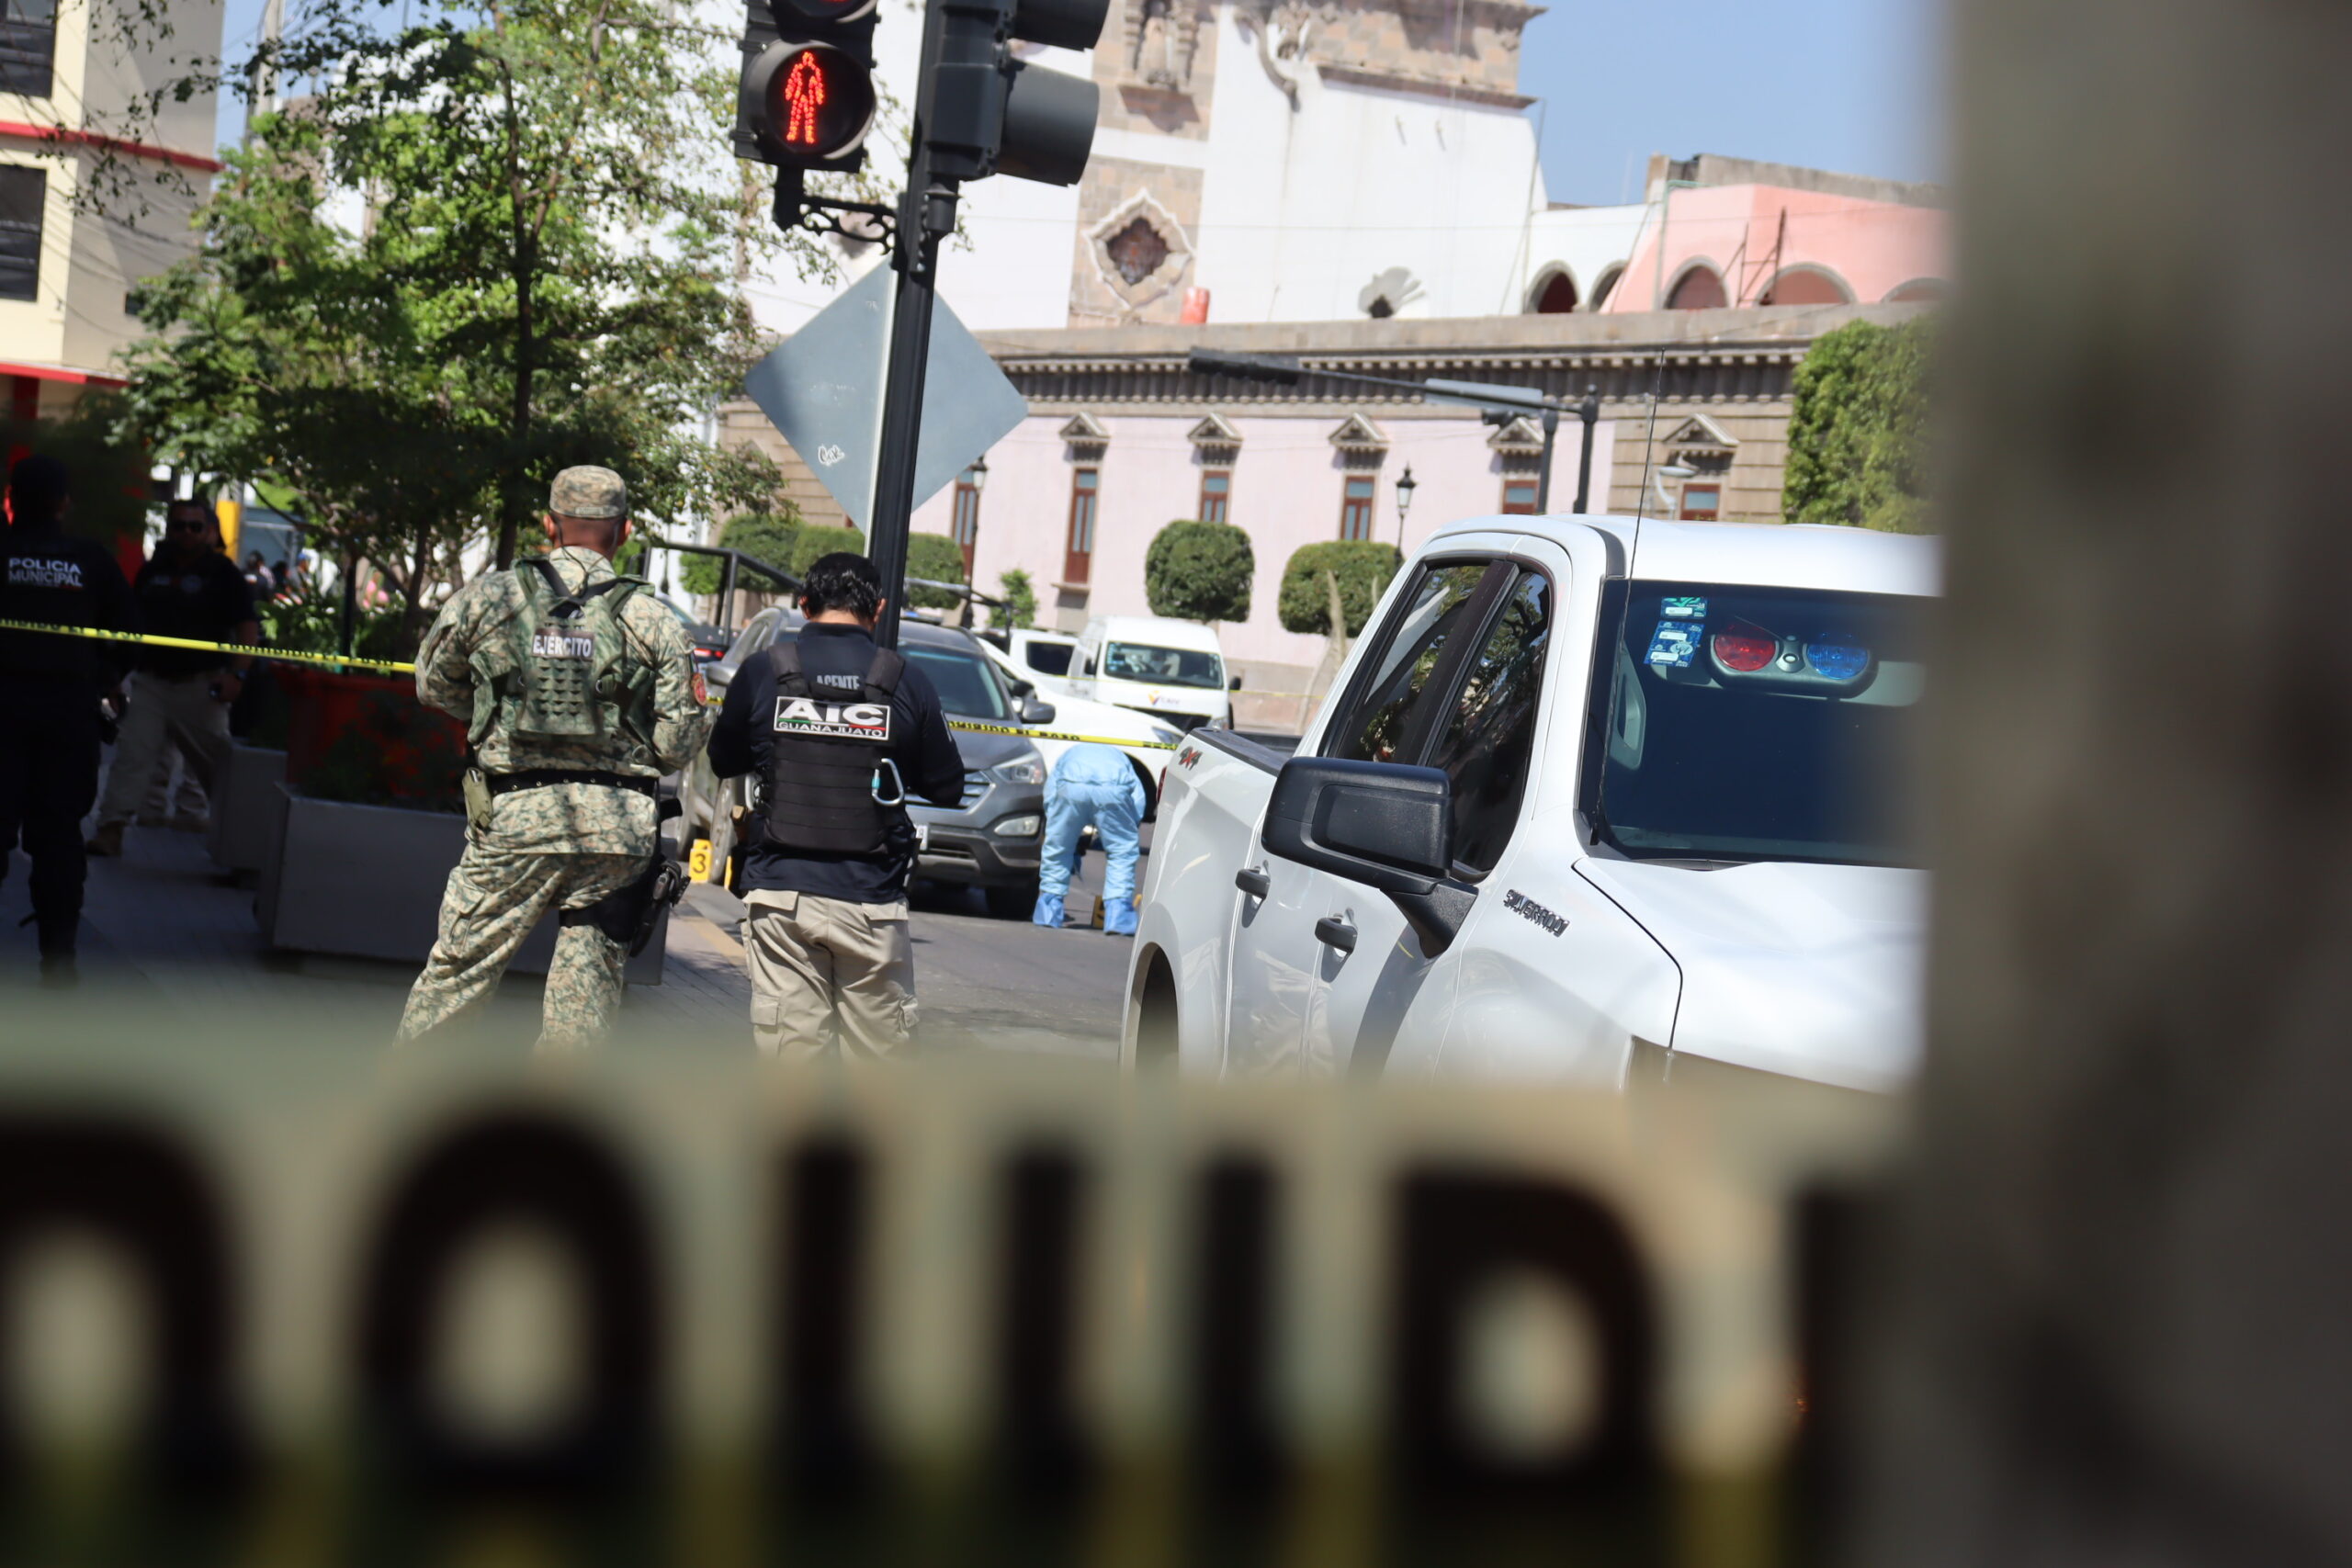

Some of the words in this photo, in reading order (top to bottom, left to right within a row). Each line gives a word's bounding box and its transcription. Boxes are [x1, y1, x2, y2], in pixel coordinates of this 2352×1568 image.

[9, 558, 82, 575] POLICIA
[9, 570, 84, 588] MUNICIPAL
[778, 699, 884, 726] AIC
[778, 721, 883, 738] GUANAJUATO
[693, 852, 707, 874] 3
[1503, 888, 1569, 938] SILVERADO
